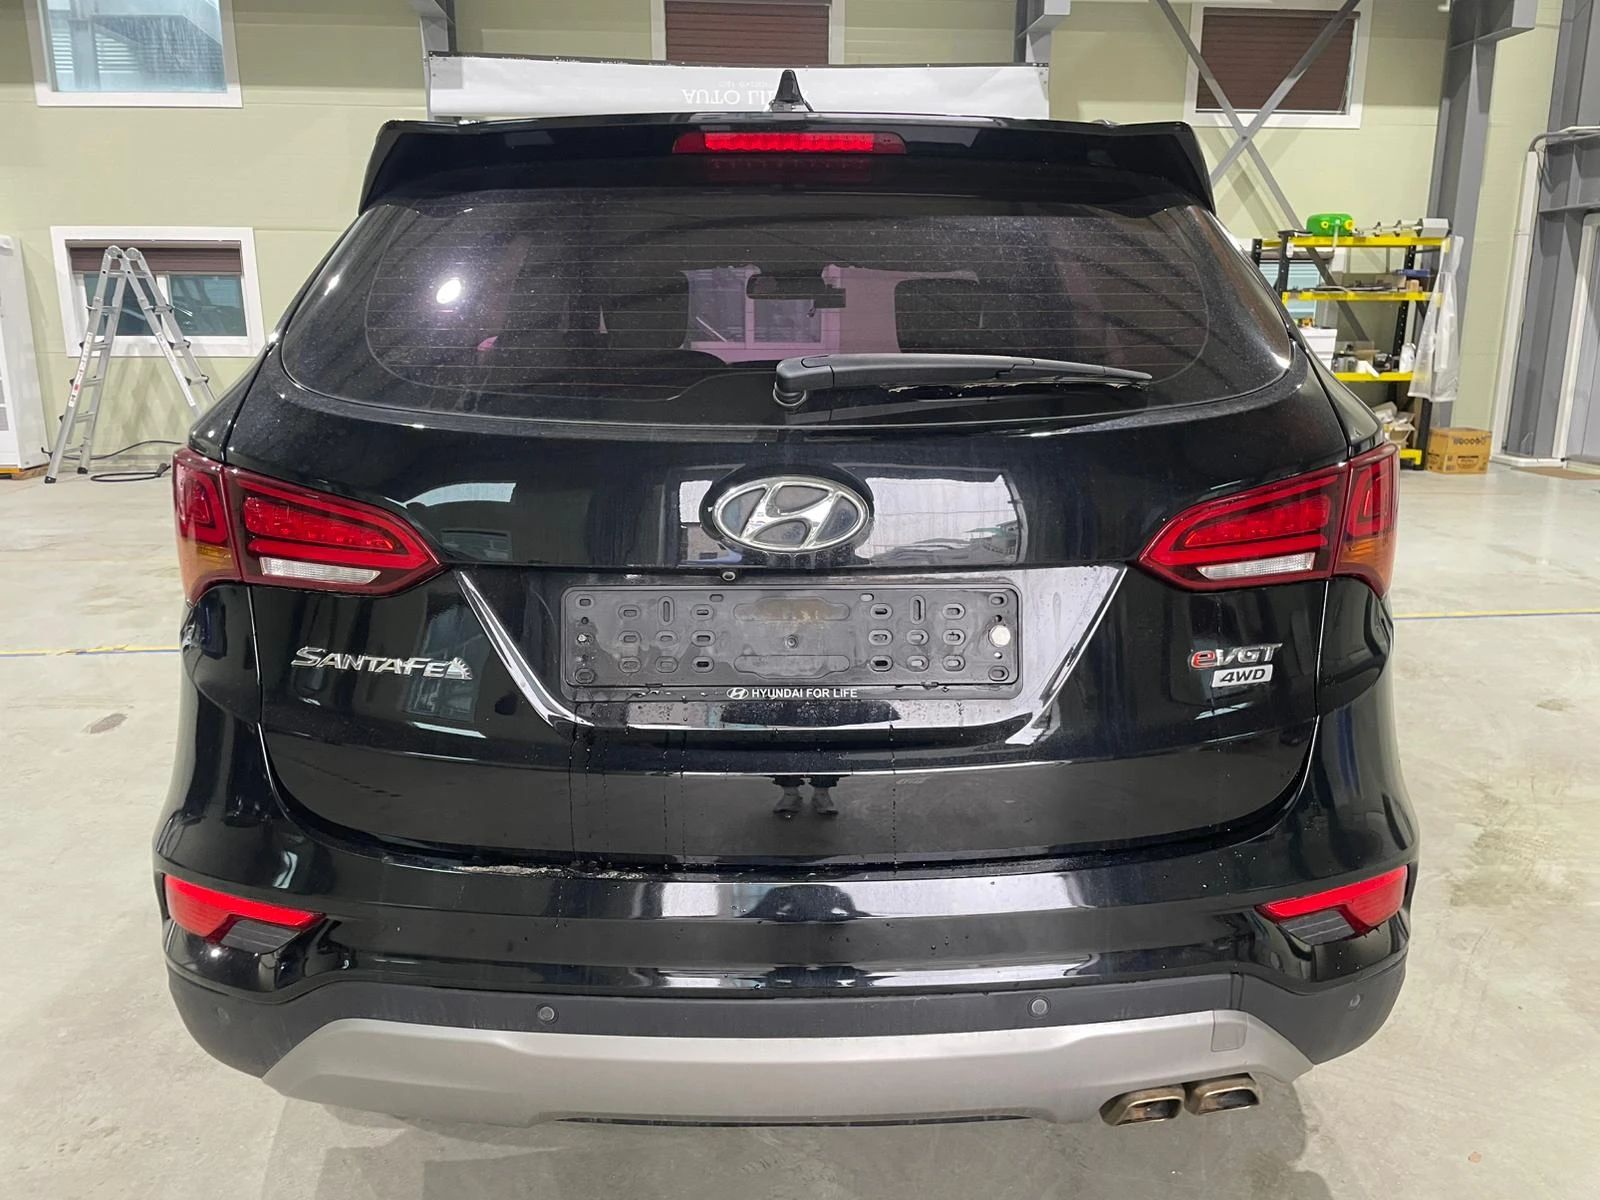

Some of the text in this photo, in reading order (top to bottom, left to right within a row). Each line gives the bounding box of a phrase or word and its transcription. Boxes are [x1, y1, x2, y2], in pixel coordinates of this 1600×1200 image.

[1190, 643, 1283, 669] eVGT
[1219, 668, 1266, 683] 4WD
[751, 688, 858, 699] HYUNDAI FOR LIFE
